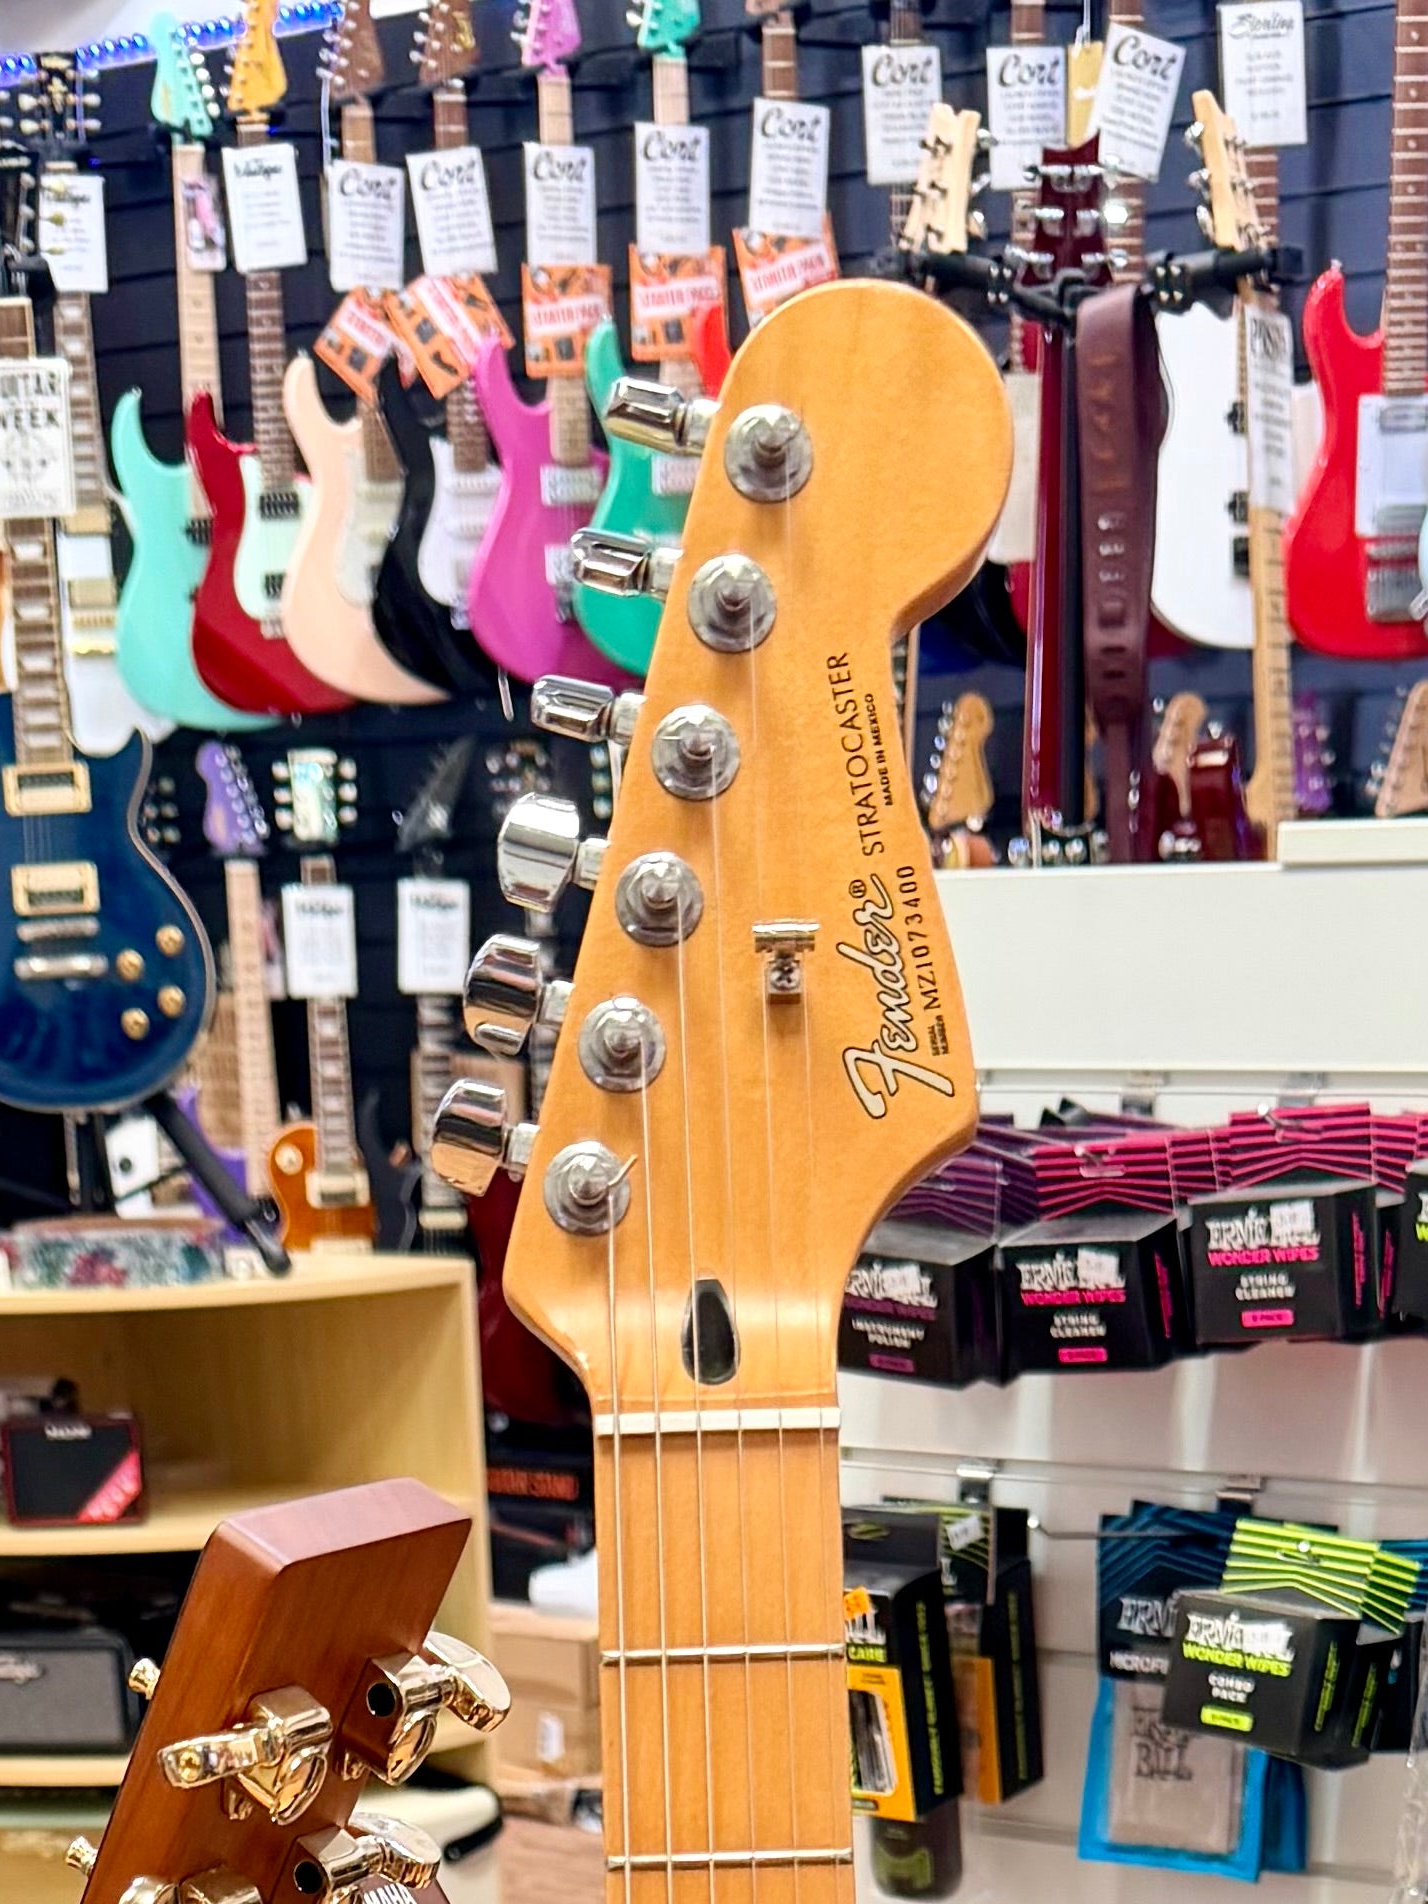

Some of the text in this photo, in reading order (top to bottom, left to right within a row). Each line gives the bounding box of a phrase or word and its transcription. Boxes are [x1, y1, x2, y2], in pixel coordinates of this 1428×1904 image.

[872, 54, 932, 87] Cort
[997, 54, 1060, 87] Cort
[1112, 35, 1177, 80] Cort
[761, 107, 821, 143] Cort
[643, 130, 701, 162] Cort
[826, 652, 885, 857] STRATOCASTER
[864, 693, 893, 806] MADE IN MEXICO
[896, 865, 942, 1011] MZ1073400
[836, 873, 955, 1119] Fender
[1207, 1247, 1320, 1267] WONDER WIPES
[1182, 1640, 1293, 1678] WONDER WIPES
